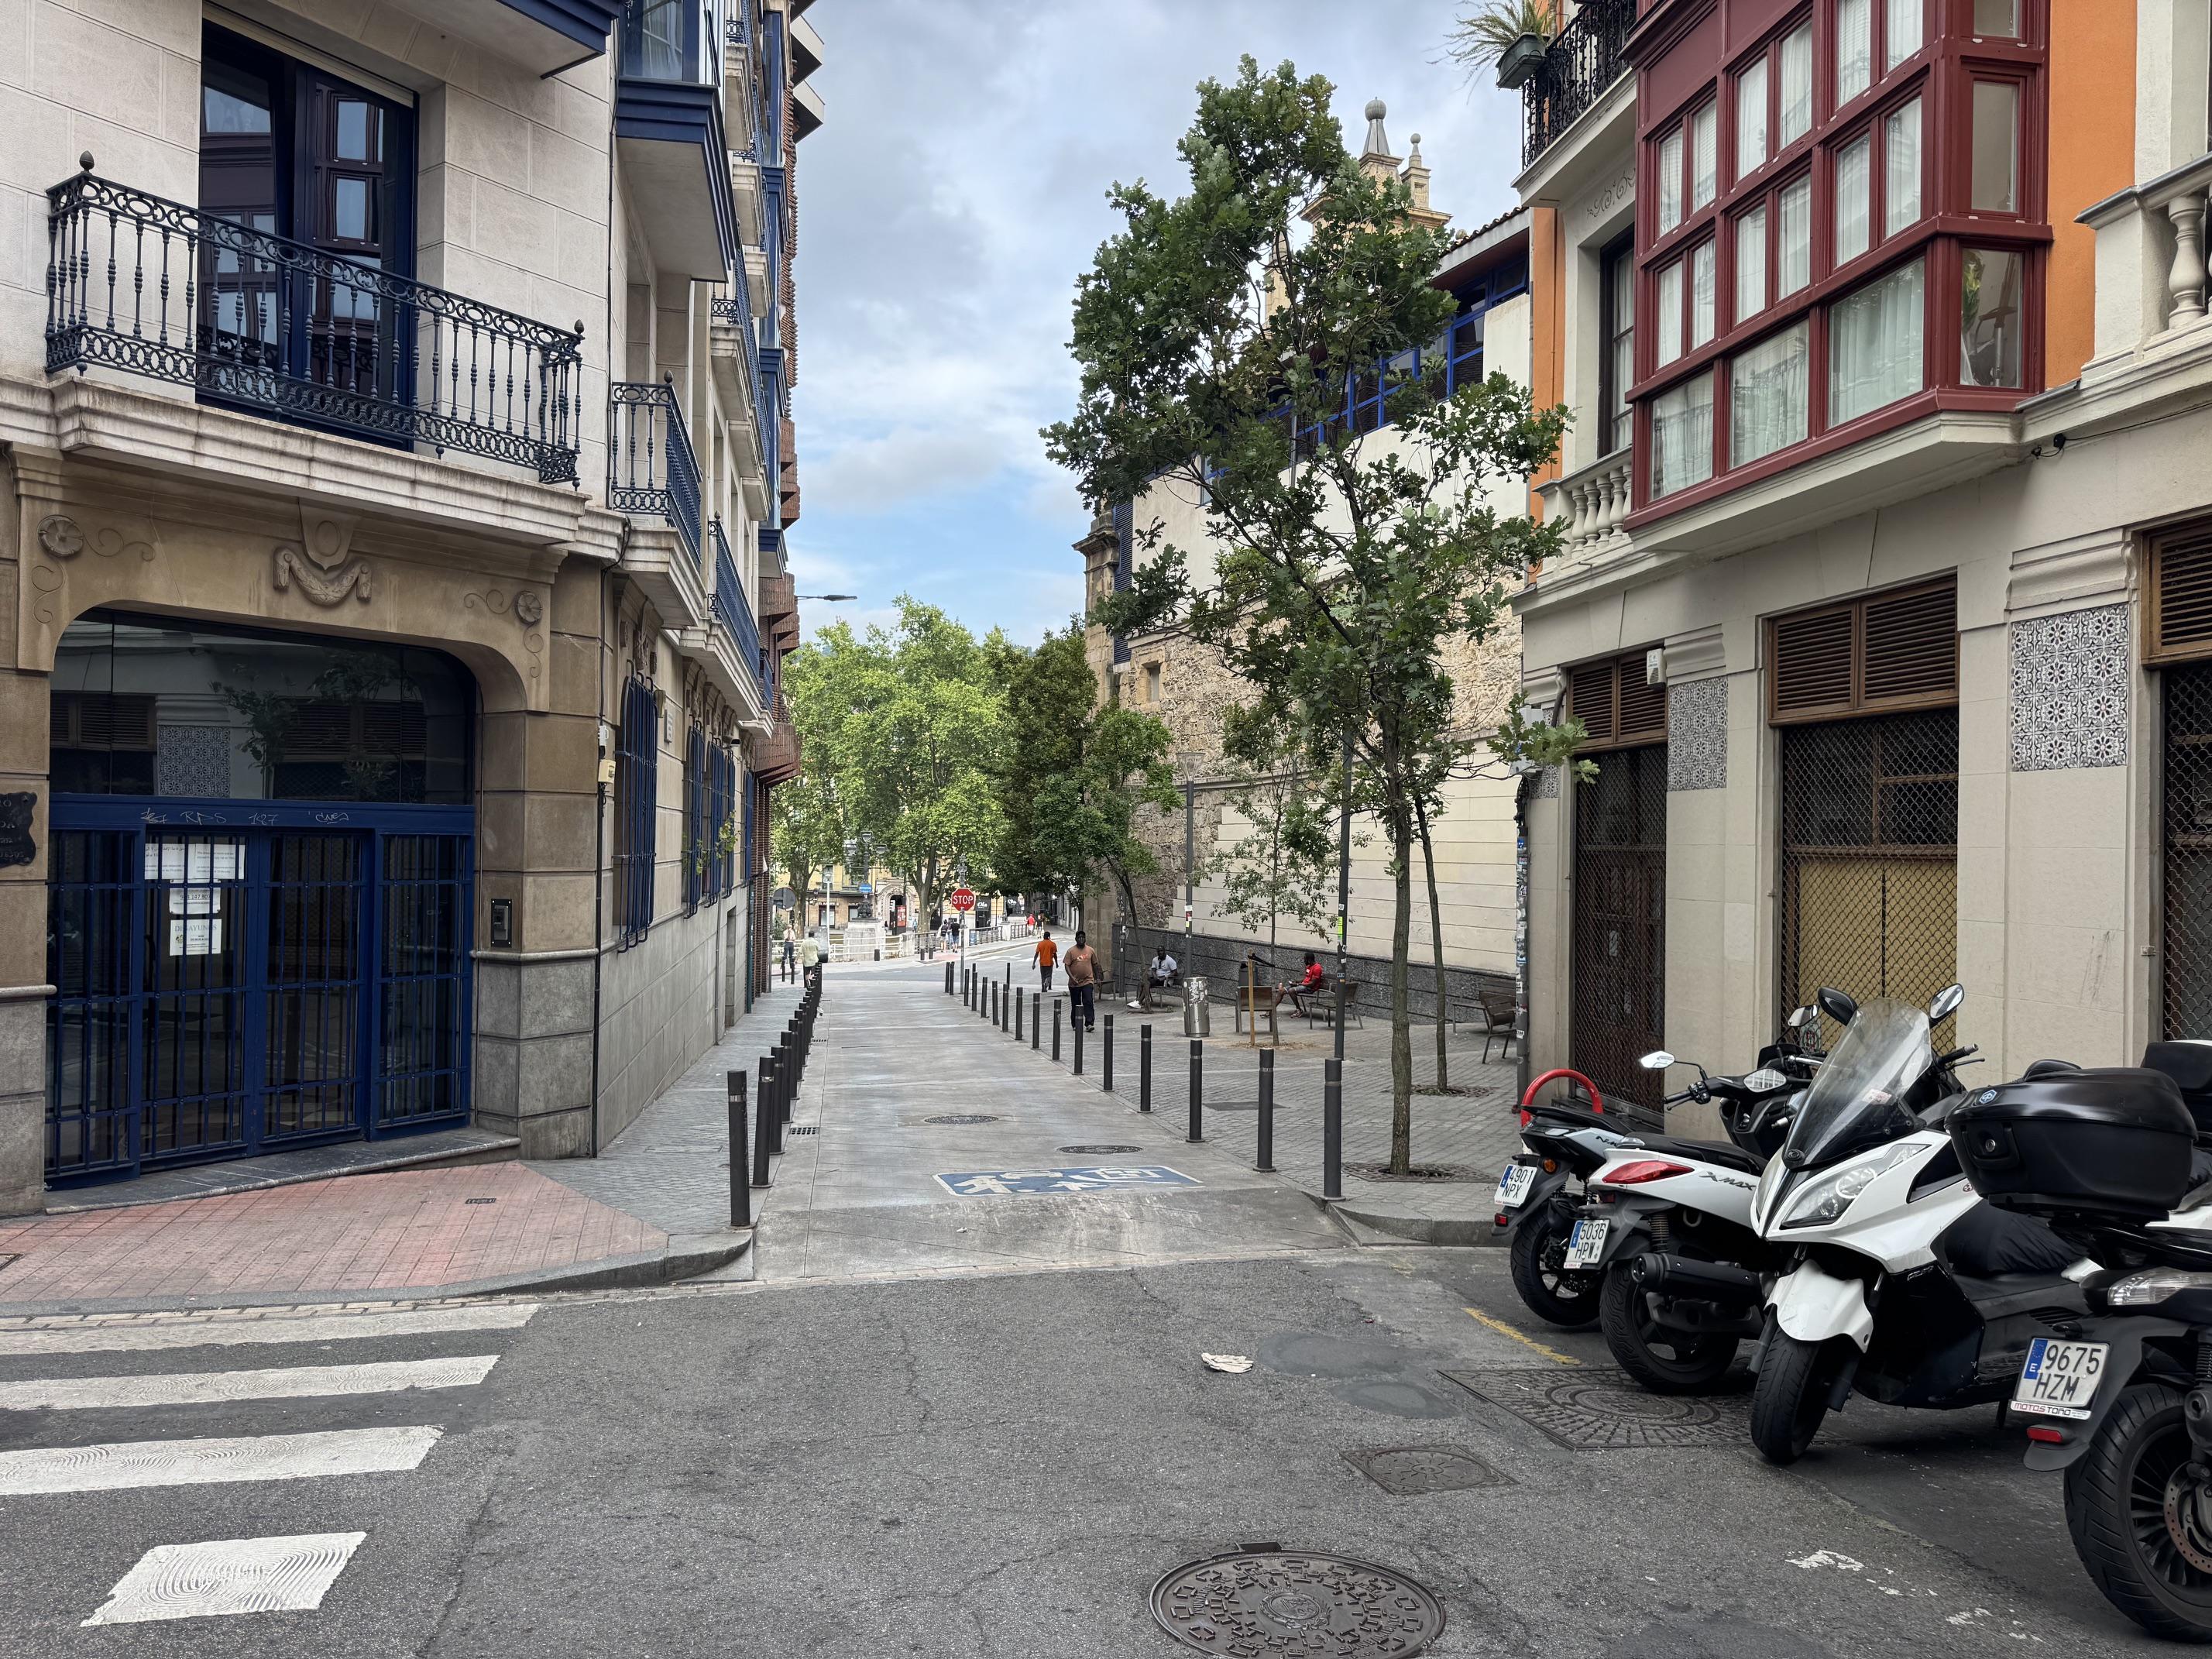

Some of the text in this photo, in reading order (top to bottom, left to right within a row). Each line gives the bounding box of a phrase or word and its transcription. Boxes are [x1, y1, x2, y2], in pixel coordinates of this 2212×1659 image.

[953, 895, 974, 905] STOP
[1510, 1167, 1534, 1184] 4901
[1502, 1183, 1522, 1199] NPX
[1579, 1223, 1606, 1240] 5036
[1575, 1242, 1595, 1259] HPW
[2028, 1362, 2038, 1373] E
[2045, 1344, 2102, 1375] 9675
[2032, 1373, 2080, 1402] HZM
[2014, 1402, 2046, 1413] MOTOS
